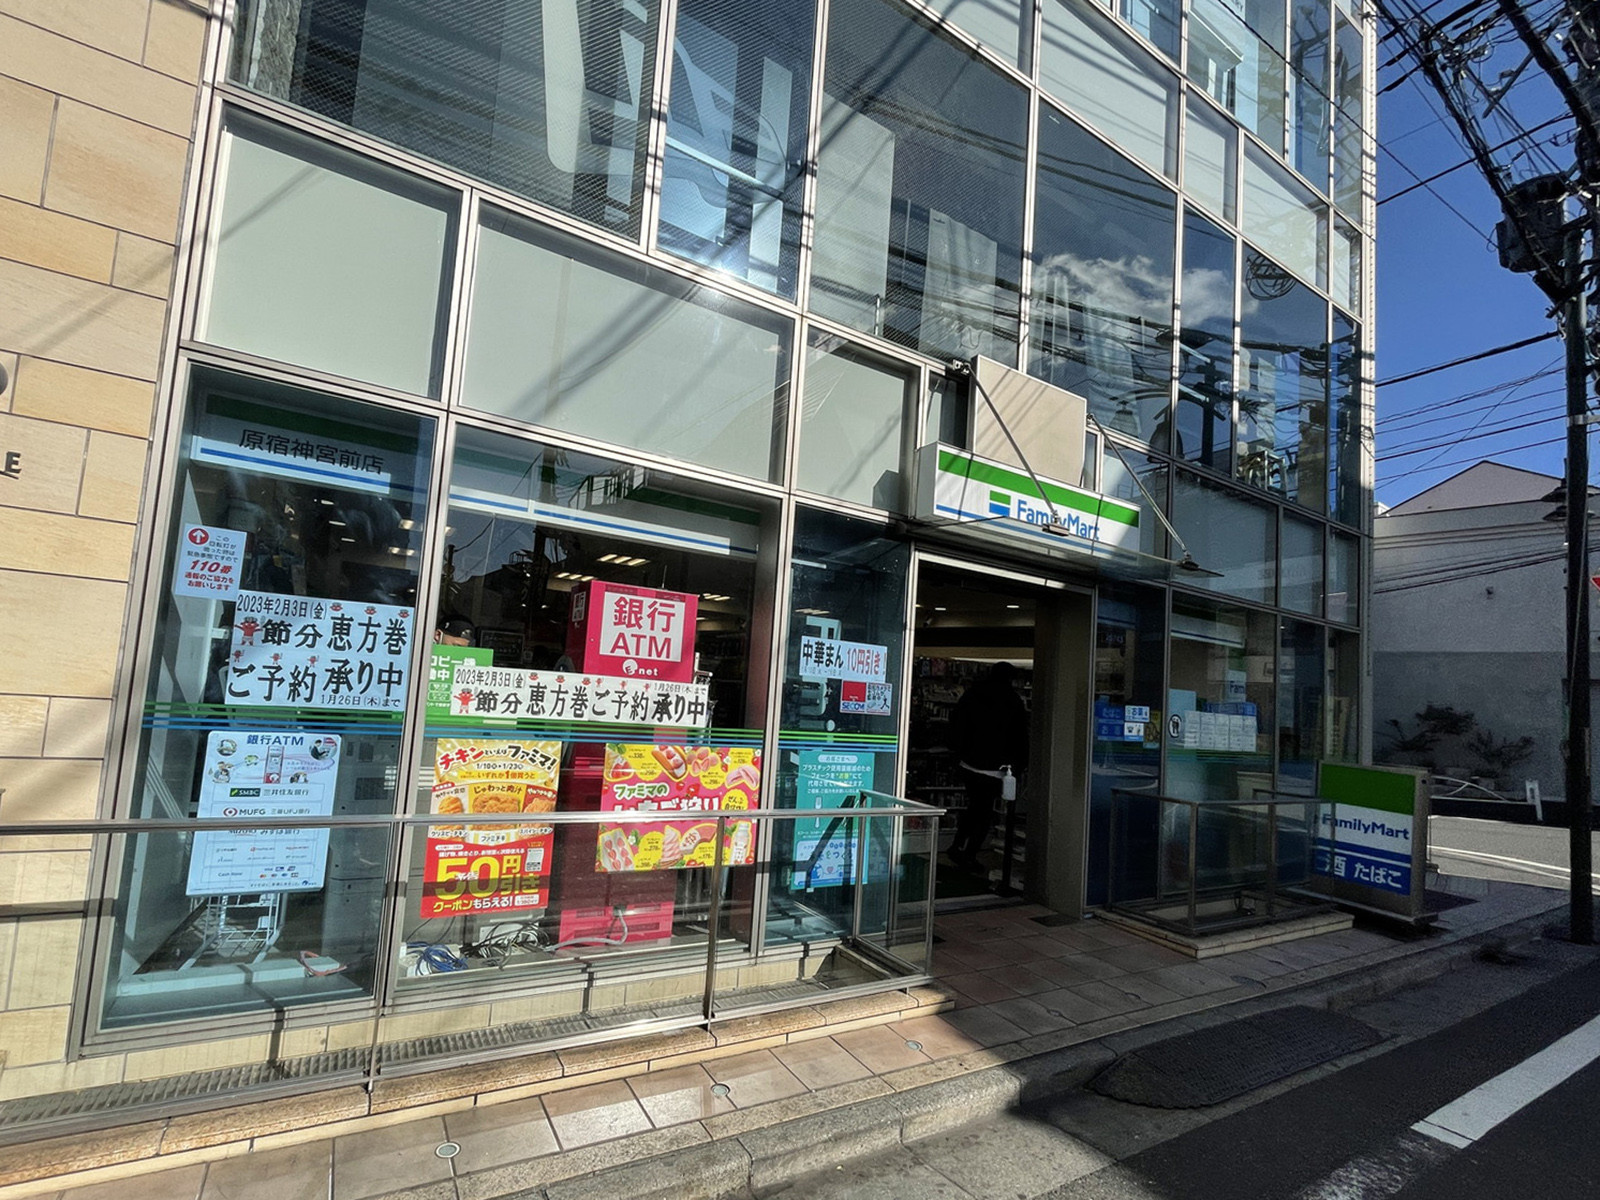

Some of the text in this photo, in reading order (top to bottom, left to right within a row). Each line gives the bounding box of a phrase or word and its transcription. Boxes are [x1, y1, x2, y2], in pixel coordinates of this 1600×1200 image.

[238, 428, 385, 475] 原宿神宮前店
[1017, 499, 1100, 540] FamiyMart
[190, 559, 232, 574] 110番
[237, 594, 327, 621] 2023年2月3日(金)
[613, 596, 676, 633] 銀行
[261, 613, 407, 656] 節分恵方巻
[610, 632, 672, 659] ATM
[803, 640, 844, 667] 中華まん
[228, 658, 403, 704] ご予約承り中
[455, 668, 526, 688] 2023年2月3日(金)
[321, 694, 401, 708] 1月26日(木)まで
[475, 681, 706, 725] 節分恵方巻ご予約承り中
[842, 702, 865, 711] SECOM
[247, 735, 304, 746] 銀行ATM
[615, 784, 668, 798] ファミマの
[239, 808, 266, 816] MUFG
[1354, 863, 1402, 889] たばこ
[433, 896, 513, 912] クーポンもらえる!
